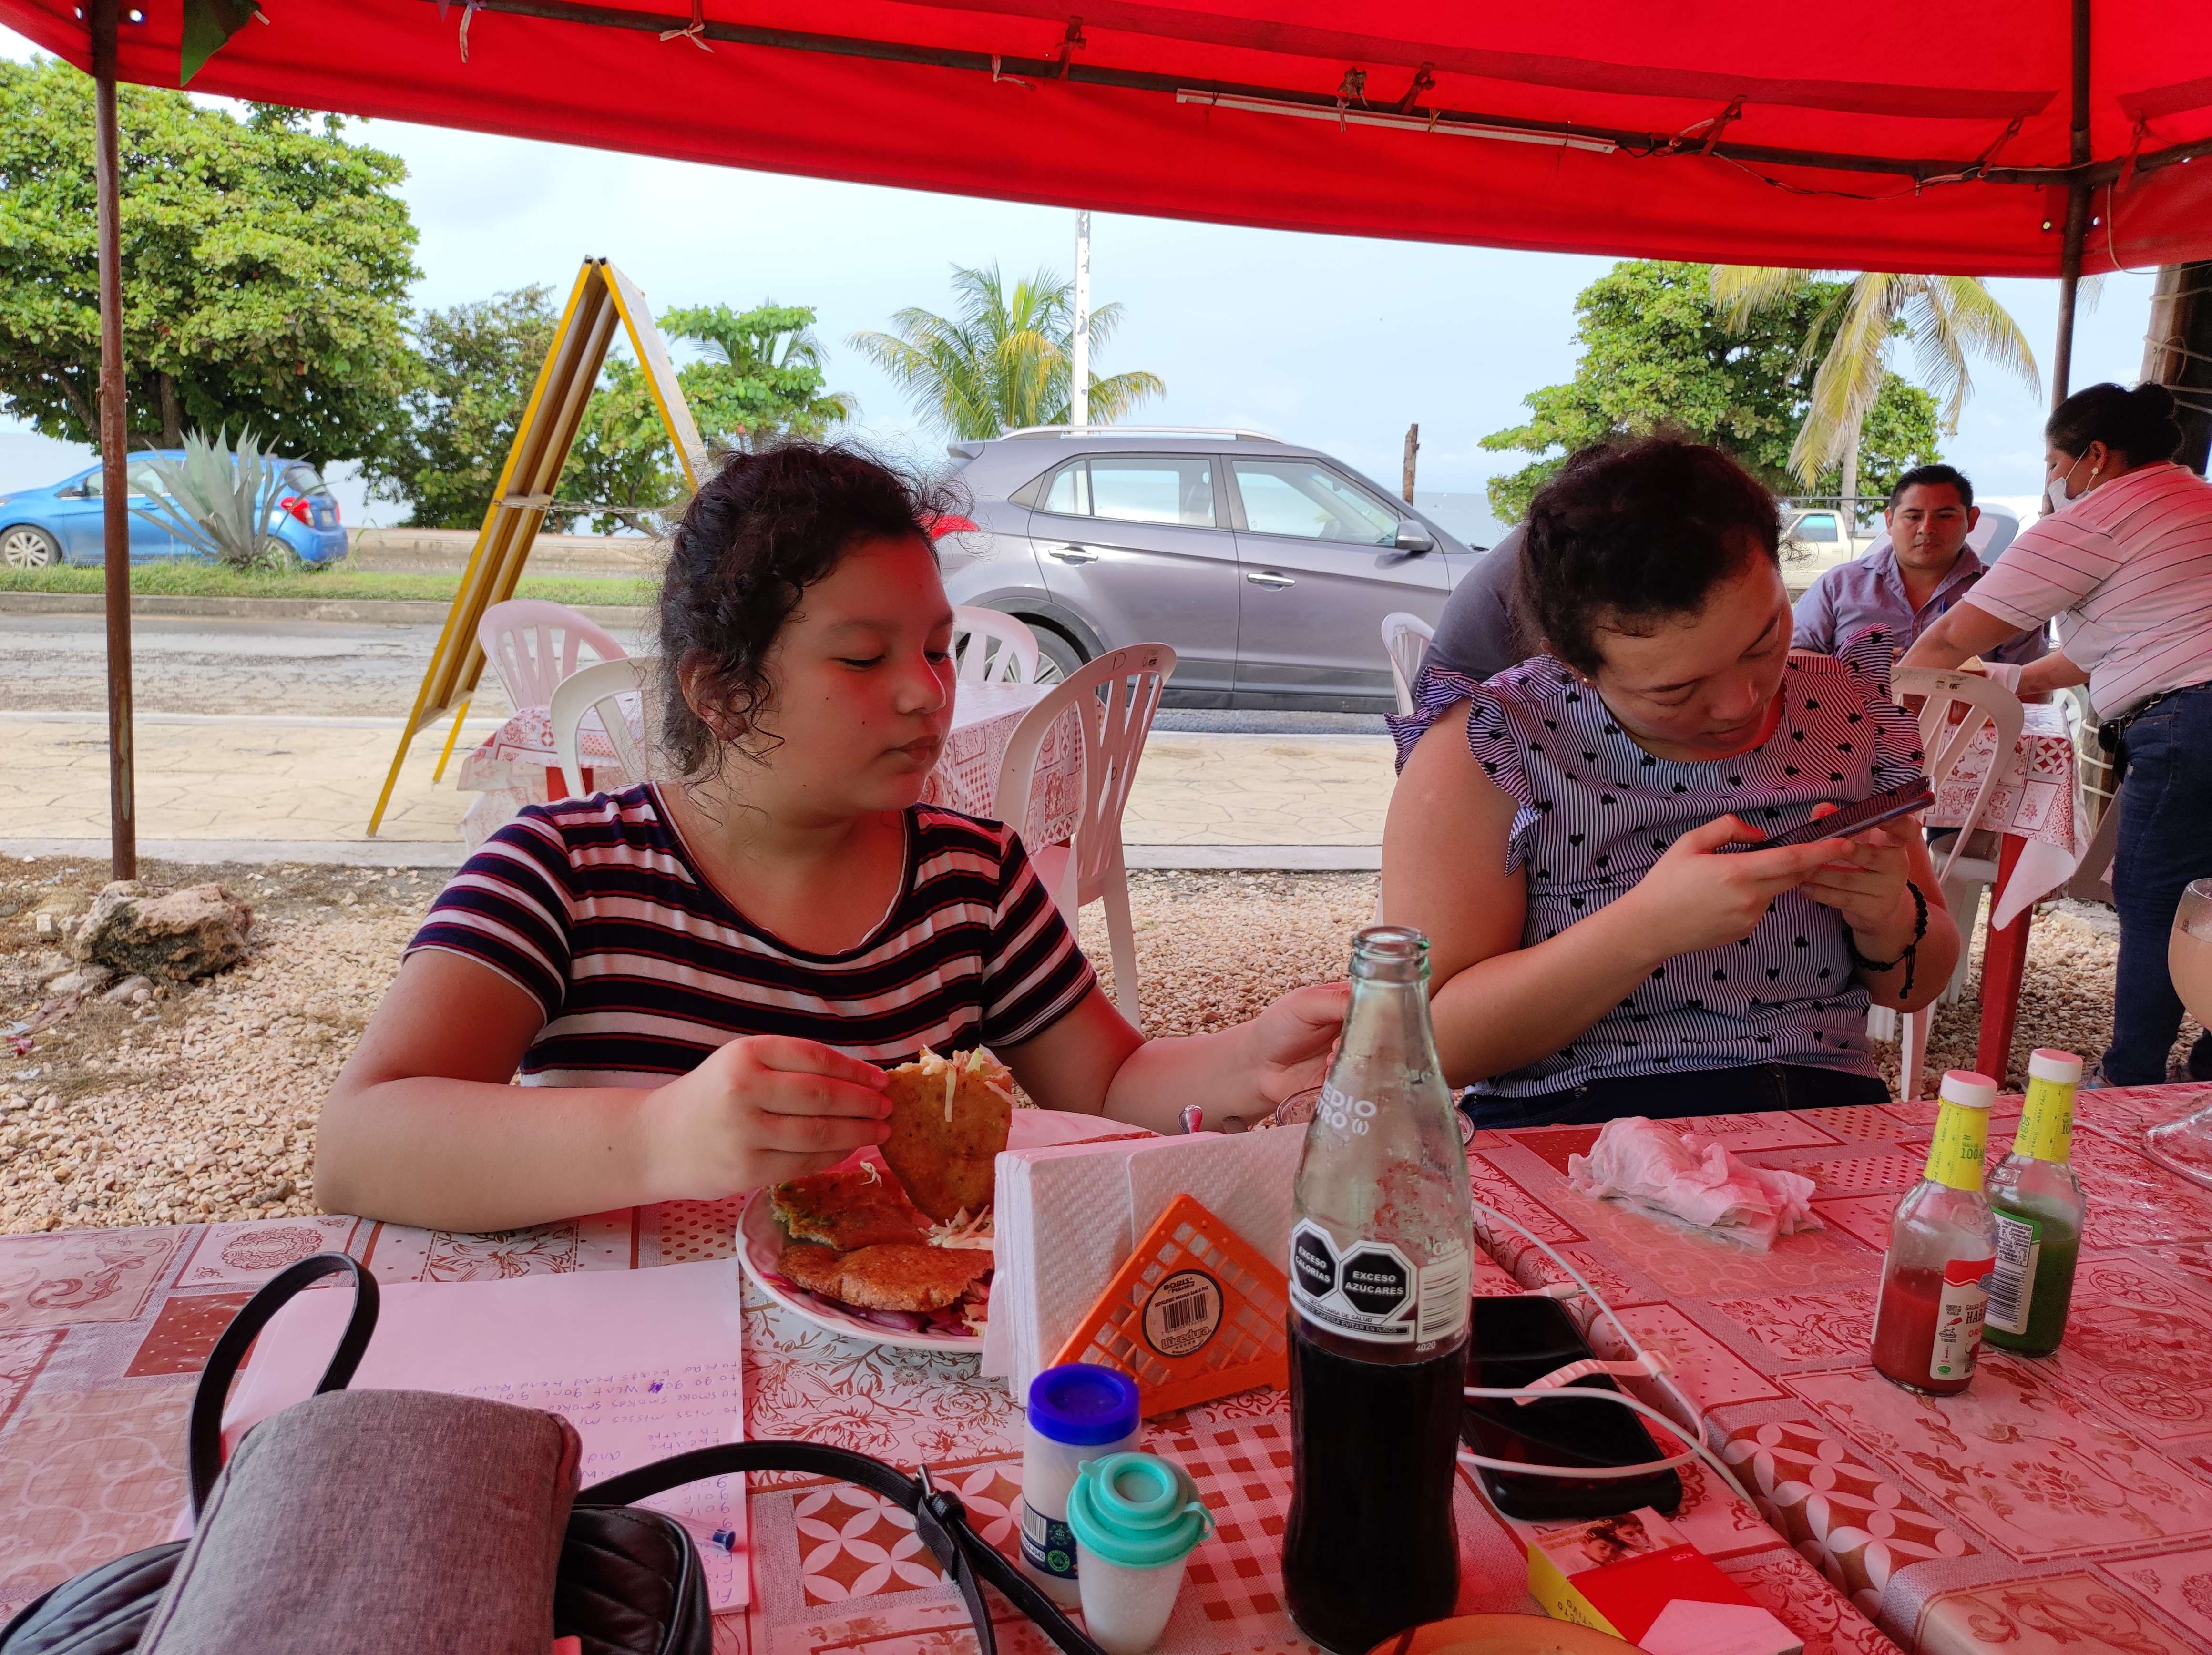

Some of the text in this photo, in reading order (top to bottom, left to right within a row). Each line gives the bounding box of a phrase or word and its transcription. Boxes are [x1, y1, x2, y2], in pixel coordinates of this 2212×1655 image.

[1323, 1081, 1377, 1117] EDIO
[1317, 1097, 1347, 1128] TRO
[2002, 1220, 2032, 1232] nutrimental
[2009, 1231, 2030, 1240] Contenido
[1298, 1246, 1327, 1269] EXCESO
[1295, 1255, 1331, 1283] CALORÍAS
[1352, 1270, 1397, 1283] EXCESO
[1345, 1281, 1403, 1295] AZÚCARES
[1351, 1314, 1372, 1322] SALUD
[1342, 1321, 1365, 1330] EVITAR
[1415, 1341, 1436, 1352] 4020
[696, 1376, 712, 1386] go
[677, 1392, 716, 1400] smoke
[722, 1389, 738, 1398] to
[612, 1396, 667, 1408] smokes
[676, 1409, 714, 1419] miss
[724, 1405, 738, 1414] to
[612, 1414, 665, 1424] misses
[588, 1451, 620, 1464] and
[682, 1476, 728, 1491] golf
[683, 1489, 729, 1503] golf
[685, 1502, 730, 1517] golf
[704, 1552, 733, 1564] Fis
[1671, 1553, 1693, 1562] 20's
[706, 1568, 733, 1583] Fis
